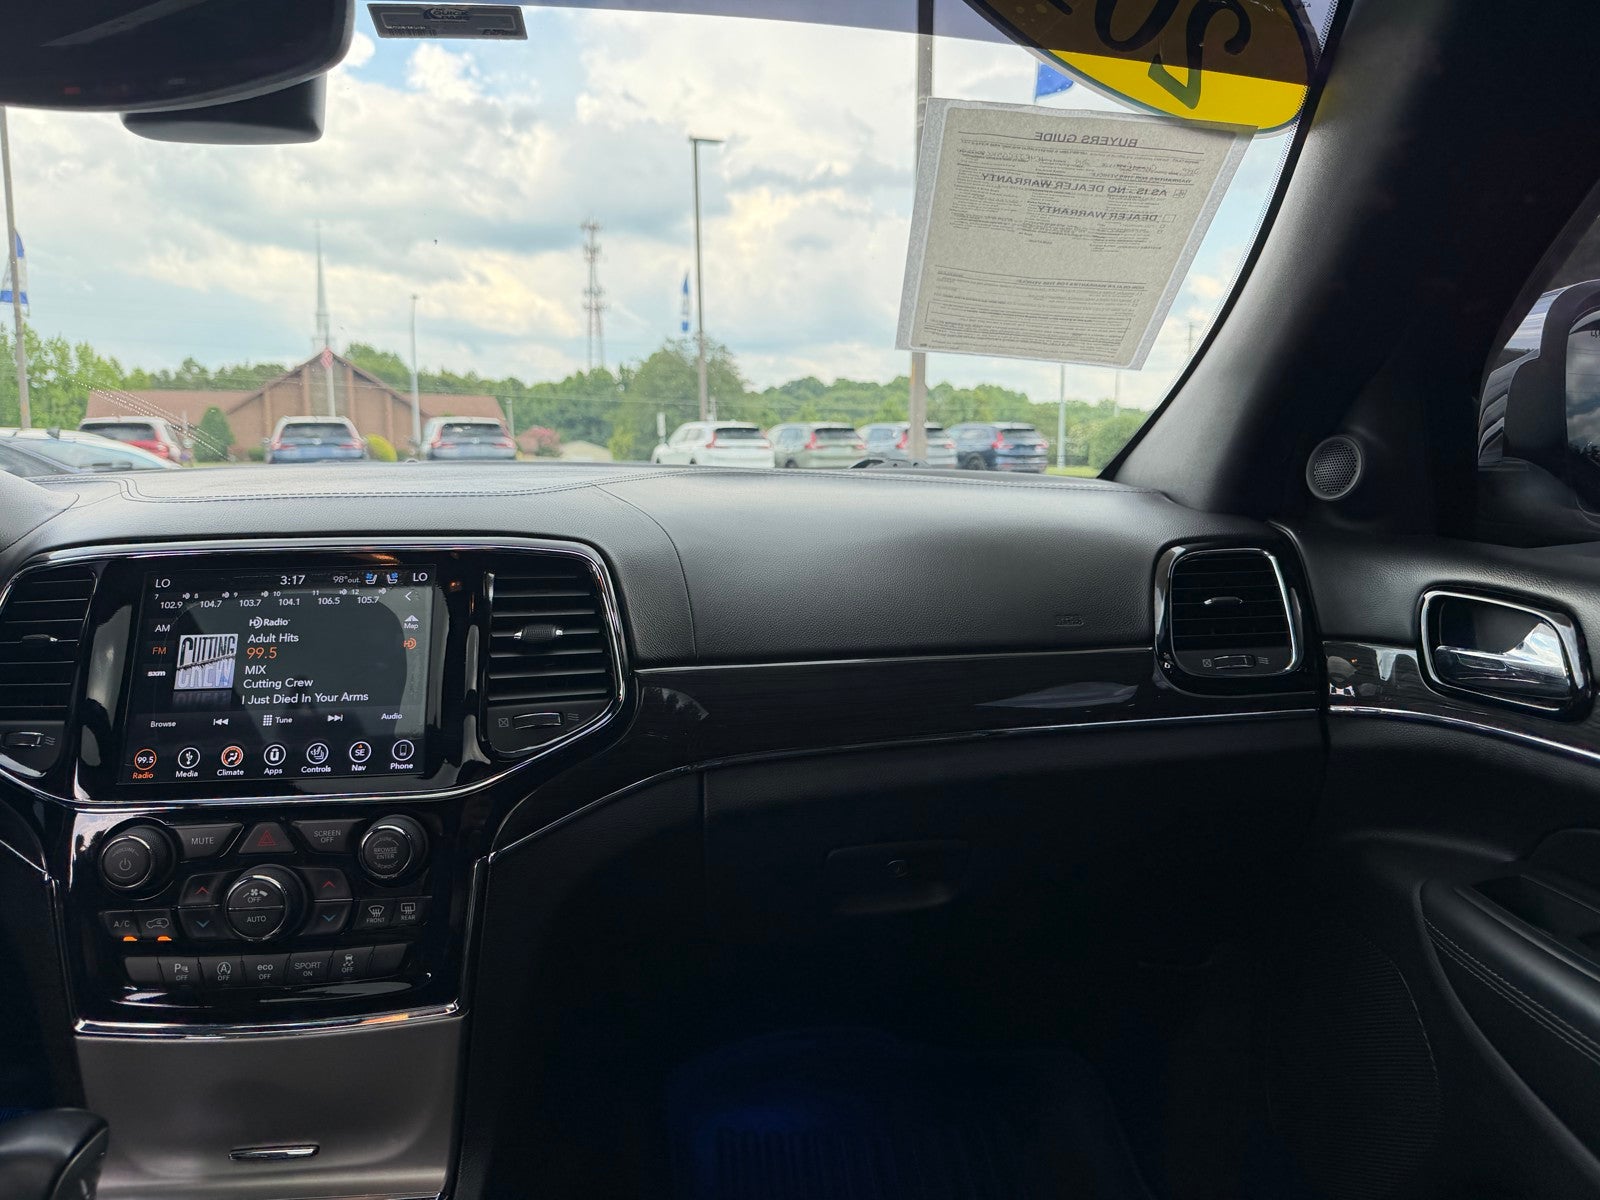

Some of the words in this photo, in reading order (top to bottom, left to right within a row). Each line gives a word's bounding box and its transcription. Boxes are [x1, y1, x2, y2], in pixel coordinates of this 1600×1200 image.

[280, 575, 305, 585] 3:17
[413, 572, 428, 582] LO
[155, 579, 170, 588] LO
[200, 600, 222, 608] 104.7
[239, 599, 261, 607] 103.7
[357, 596, 380, 604] 105.7
[160, 601, 183, 609] 102.9
[263, 618, 289, 627] Radio
[248, 634, 276, 644] Adult
[279, 633, 299, 643] Hits
[178, 636, 235, 667] CUTTING
[247, 647, 277, 659] 99.5
[245, 665, 267, 675] MIX
[243, 679, 282, 689] Cutting
[285, 678, 313, 688] Crew
[242, 695, 245, 704] I
[247, 695, 270, 705] Just
[273, 693, 298, 704] Died
[301, 693, 311, 703] In
[314, 693, 339, 702] Your
[341, 692, 369, 702] Arms
[137, 756, 154, 764] 99.5
[314, 830, 341, 838] SCREEN
[191, 837, 214, 845] MUTE
[246, 915, 266, 923] AUTO
[114, 920, 130, 928] A/C
